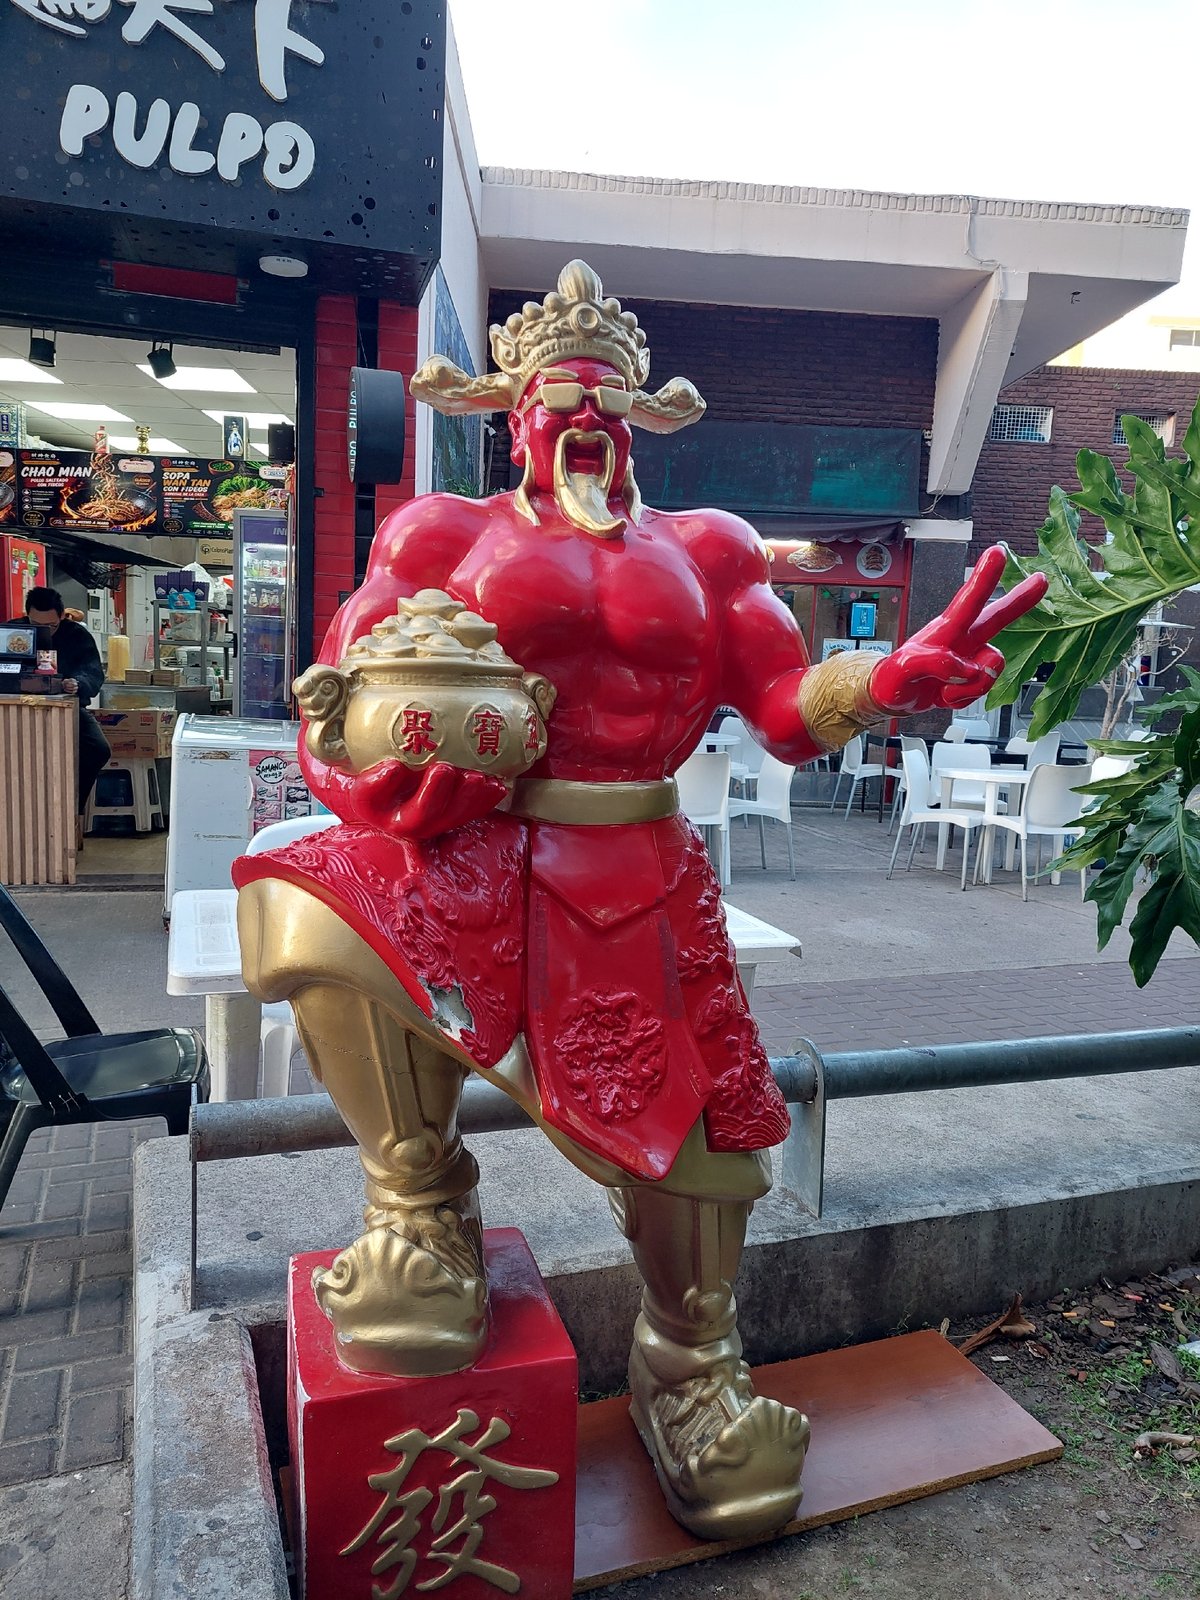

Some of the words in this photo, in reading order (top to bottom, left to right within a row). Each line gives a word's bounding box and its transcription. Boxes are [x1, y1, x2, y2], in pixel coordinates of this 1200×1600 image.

[60, 84, 315, 190] PULPO
[21, 466, 55, 478] CHAO
[58, 466, 92, 478] MIAN
[162, 472, 190, 480] SOPA
[163, 479, 187, 487] WAN
[190, 479, 211, 487] TAN
[255, 761, 288, 777] SAMANCO
[338, 1408, 560, 1600] 發
